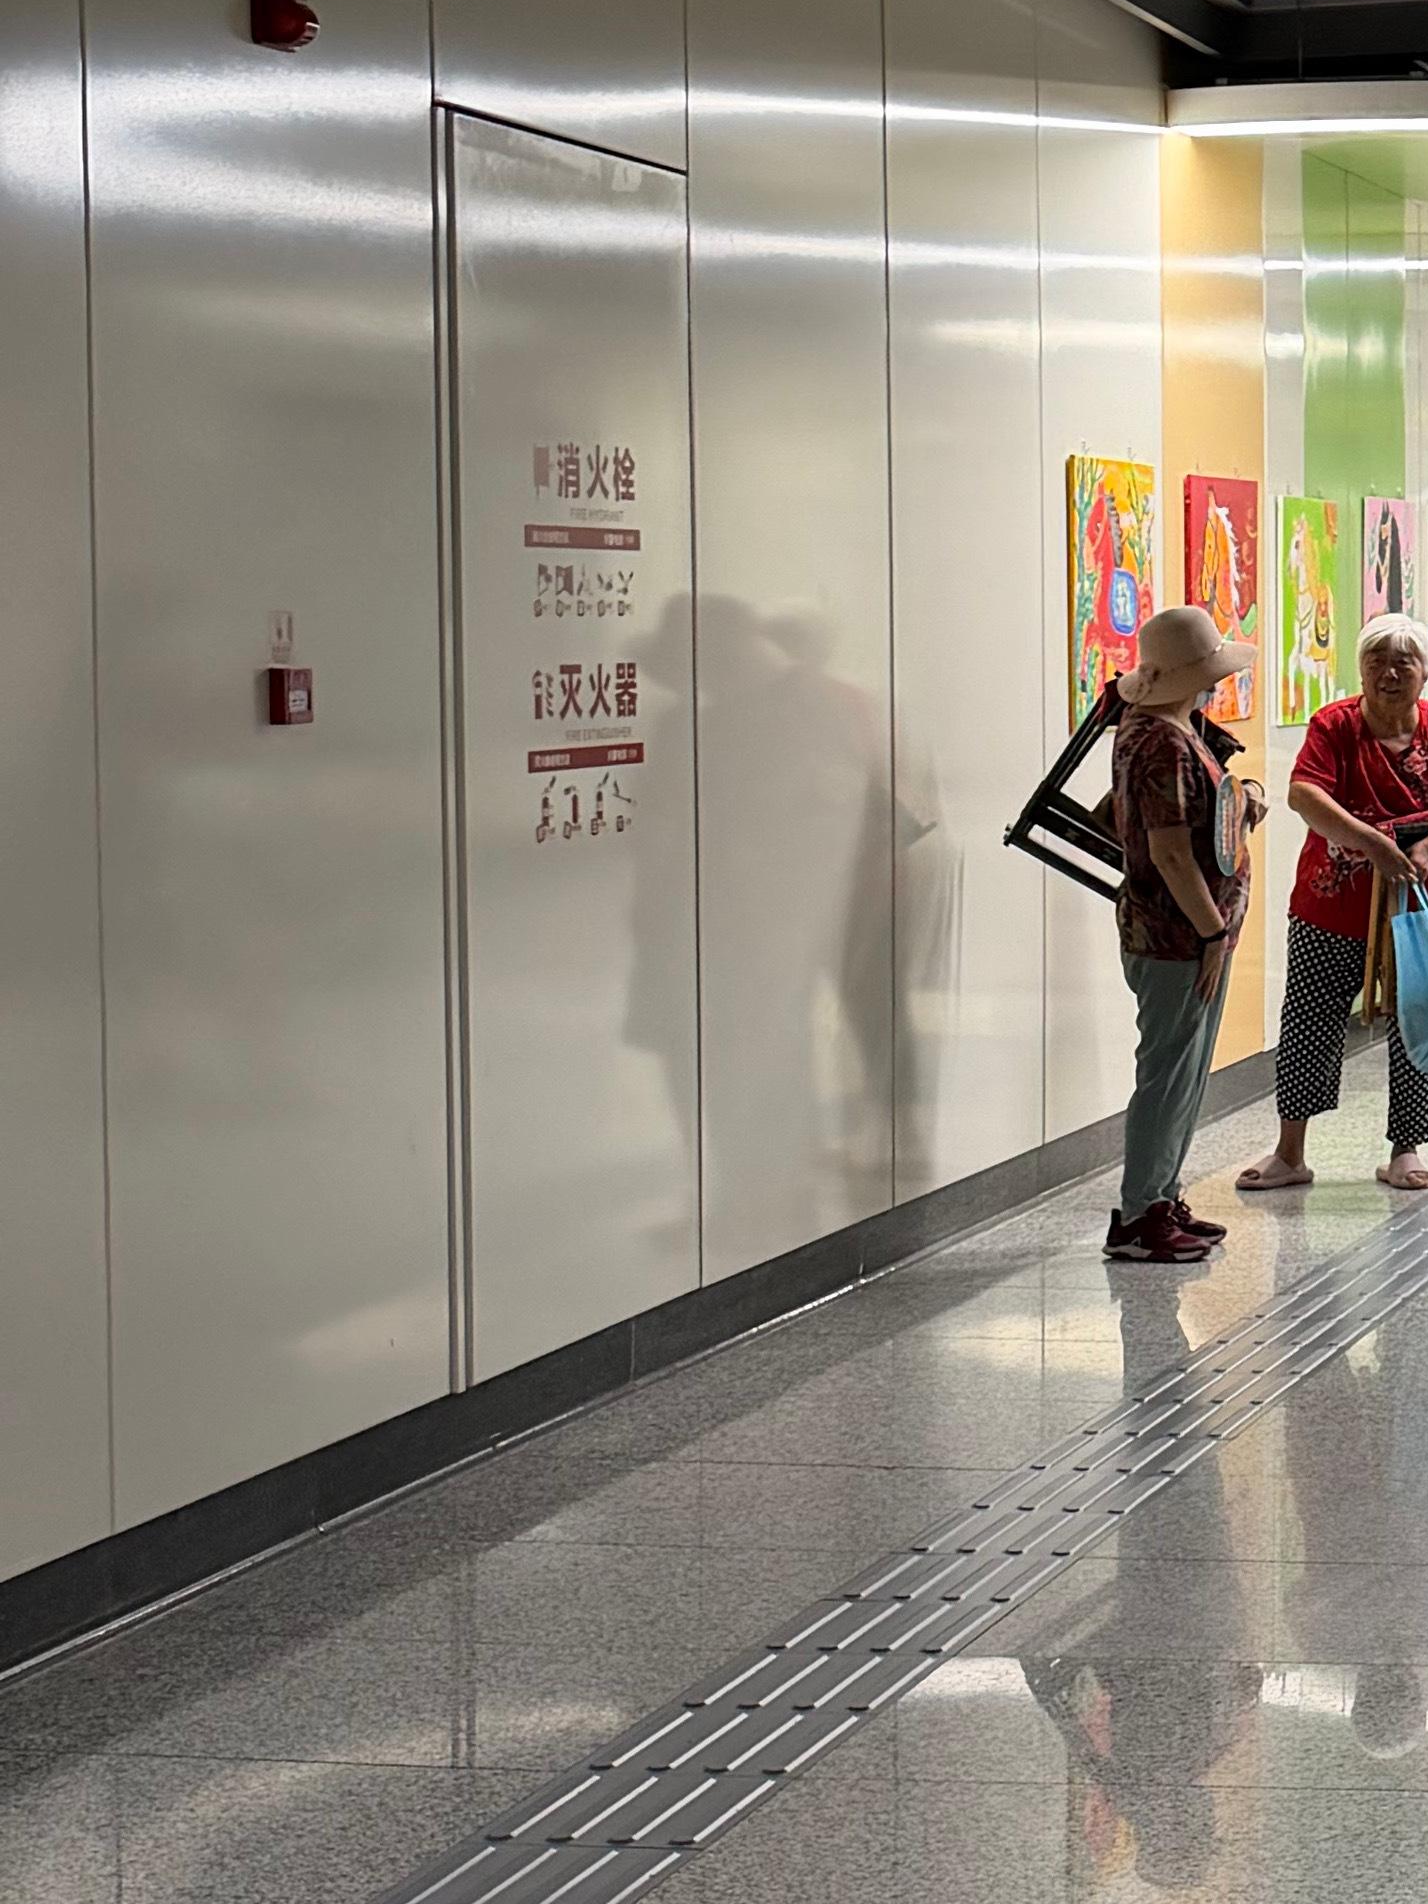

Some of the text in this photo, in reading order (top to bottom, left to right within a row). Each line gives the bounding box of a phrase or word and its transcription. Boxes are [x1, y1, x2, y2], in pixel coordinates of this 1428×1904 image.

[557, 442, 635, 501] 消火栓
[559, 663, 638, 720] 灭火器
